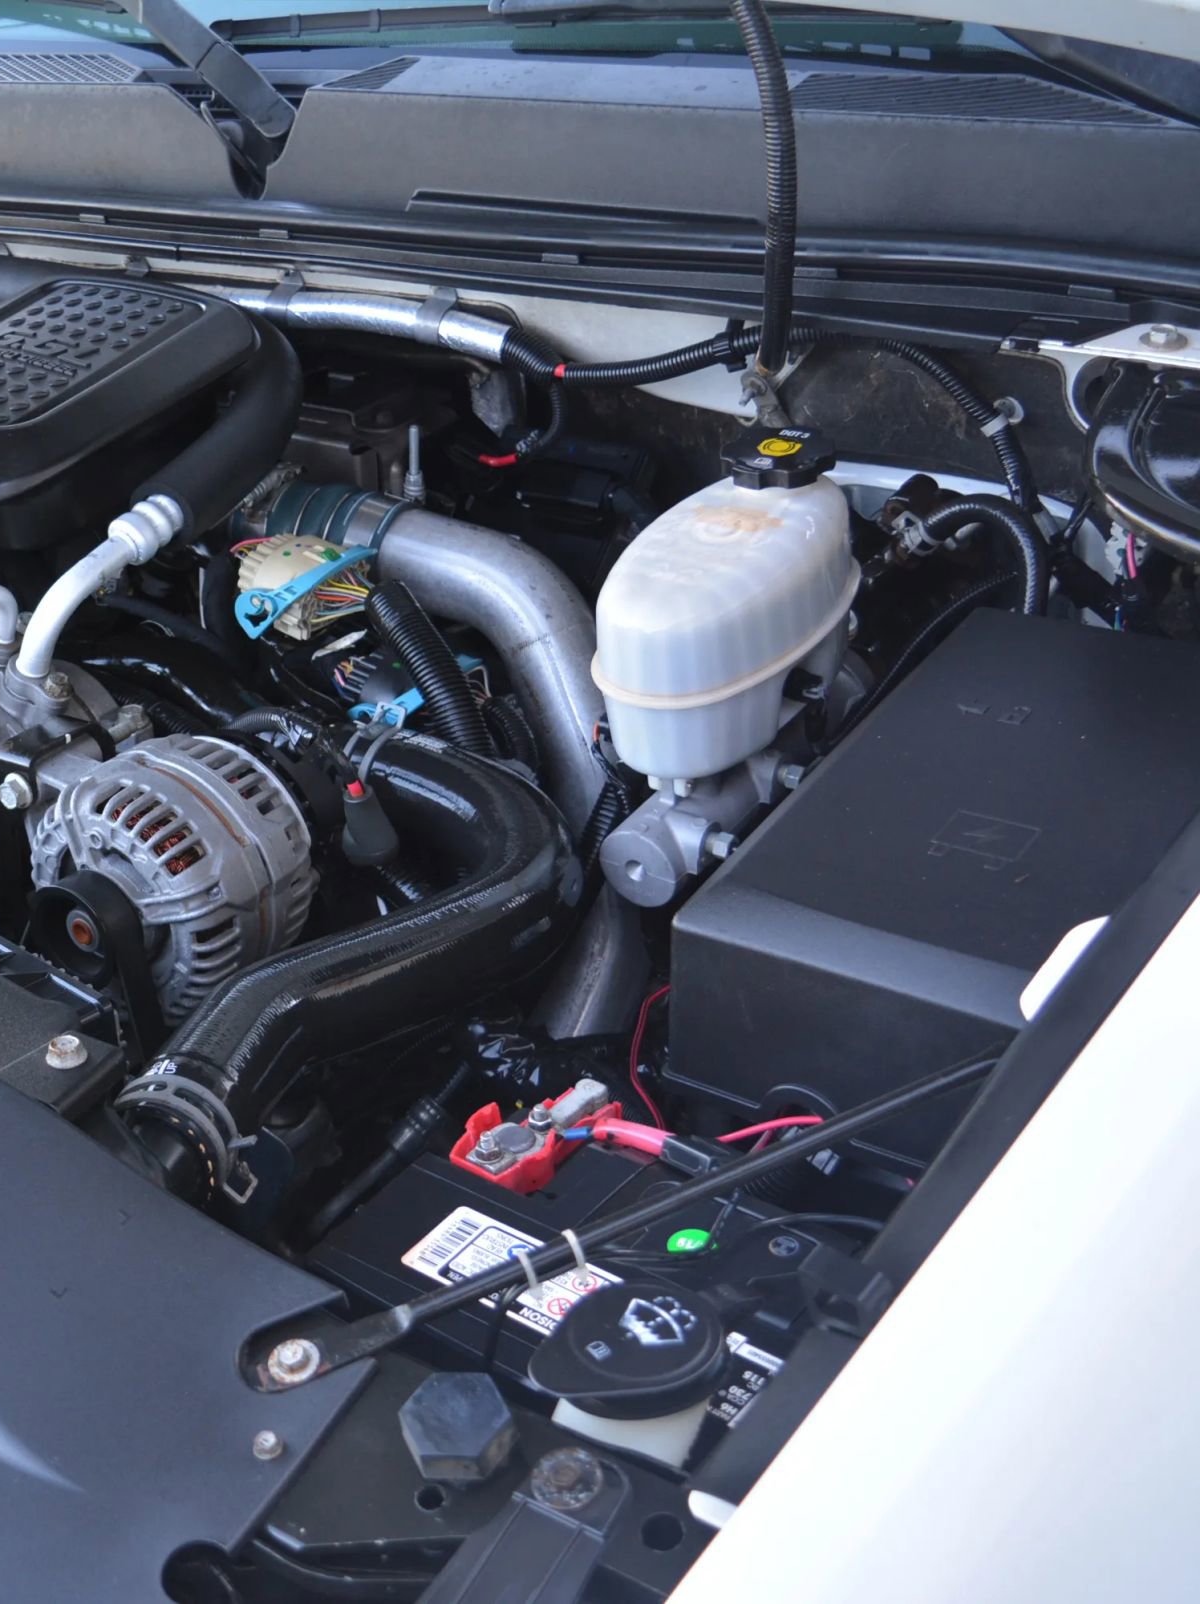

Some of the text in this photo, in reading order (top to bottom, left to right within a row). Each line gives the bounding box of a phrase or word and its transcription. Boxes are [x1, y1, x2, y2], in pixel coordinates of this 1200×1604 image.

[779, 429, 802, 437] DOT
[519, 1306, 558, 1330] ISON
[728, 1385, 753, 1400] 730
